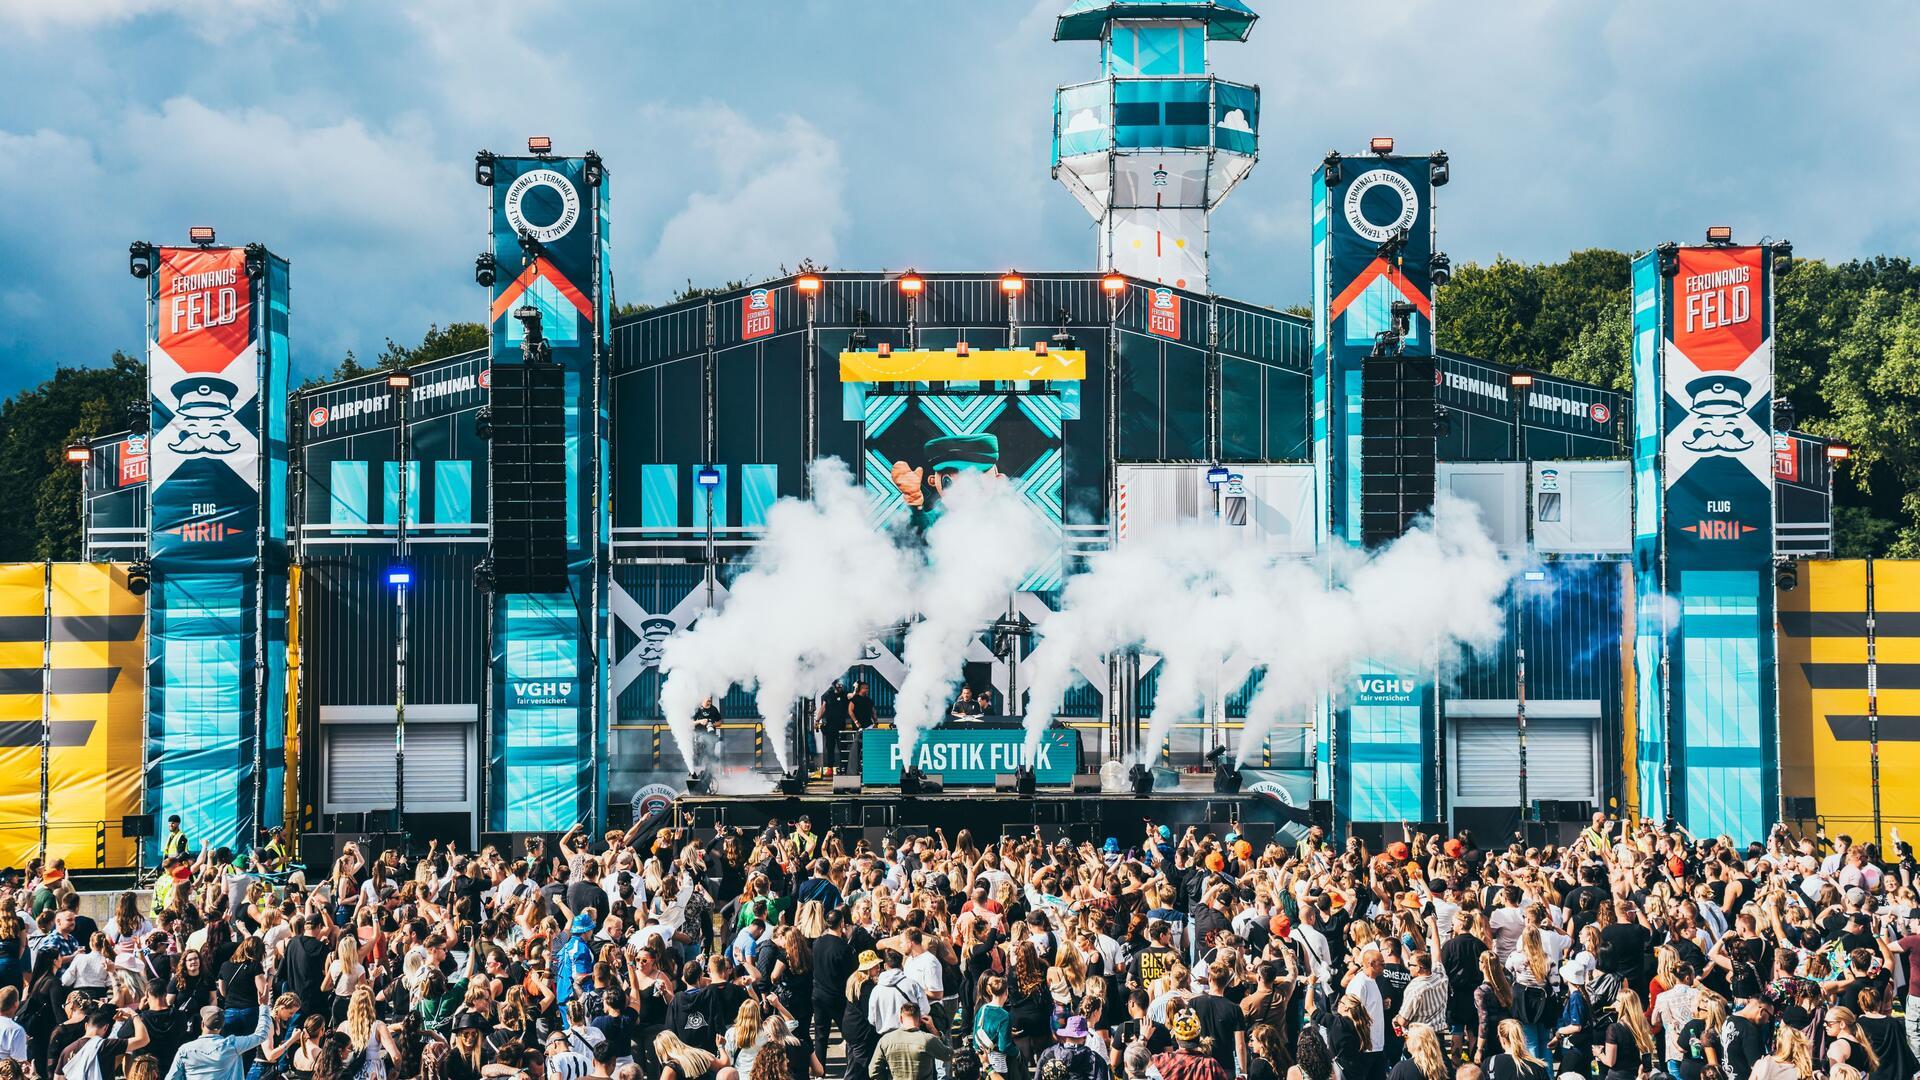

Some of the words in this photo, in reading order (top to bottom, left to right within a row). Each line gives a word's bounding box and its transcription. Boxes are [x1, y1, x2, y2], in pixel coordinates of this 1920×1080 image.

[509, 176, 533, 204] TERMINAL
[543, 174, 571, 199] TERMINAL
[1348, 176, 1373, 204] TERMINAL
[1382, 173, 1411, 198] TERMINAL
[513, 215, 541, 239] TERNAL
[553, 208, 576, 236] TERMINAL
[1351, 215, 1380, 239] TERMINAL
[172, 268, 237, 294] FERDINANDS
[1686, 266, 1750, 293] FERDINANDS
[171, 287, 237, 334] FELD
[1686, 285, 1750, 333] FELD
[747, 316, 770, 334] FELD
[1152, 315, 1174, 333] FELD
[330, 394, 391, 421] AIRPORT
[411, 375, 477, 402] TERMINAL
[1444, 372, 1508, 402] TERMINAL
[1528, 392, 1589, 418] AIRPORT
[1774, 458, 1792, 475] ELD
[192, 503, 216, 515] FLUG
[1707, 501, 1731, 513] FLUG
[513, 682, 556, 696] VGH
[1357, 680, 1400, 693] VGH
[890, 743, 984, 770] PASTIK
